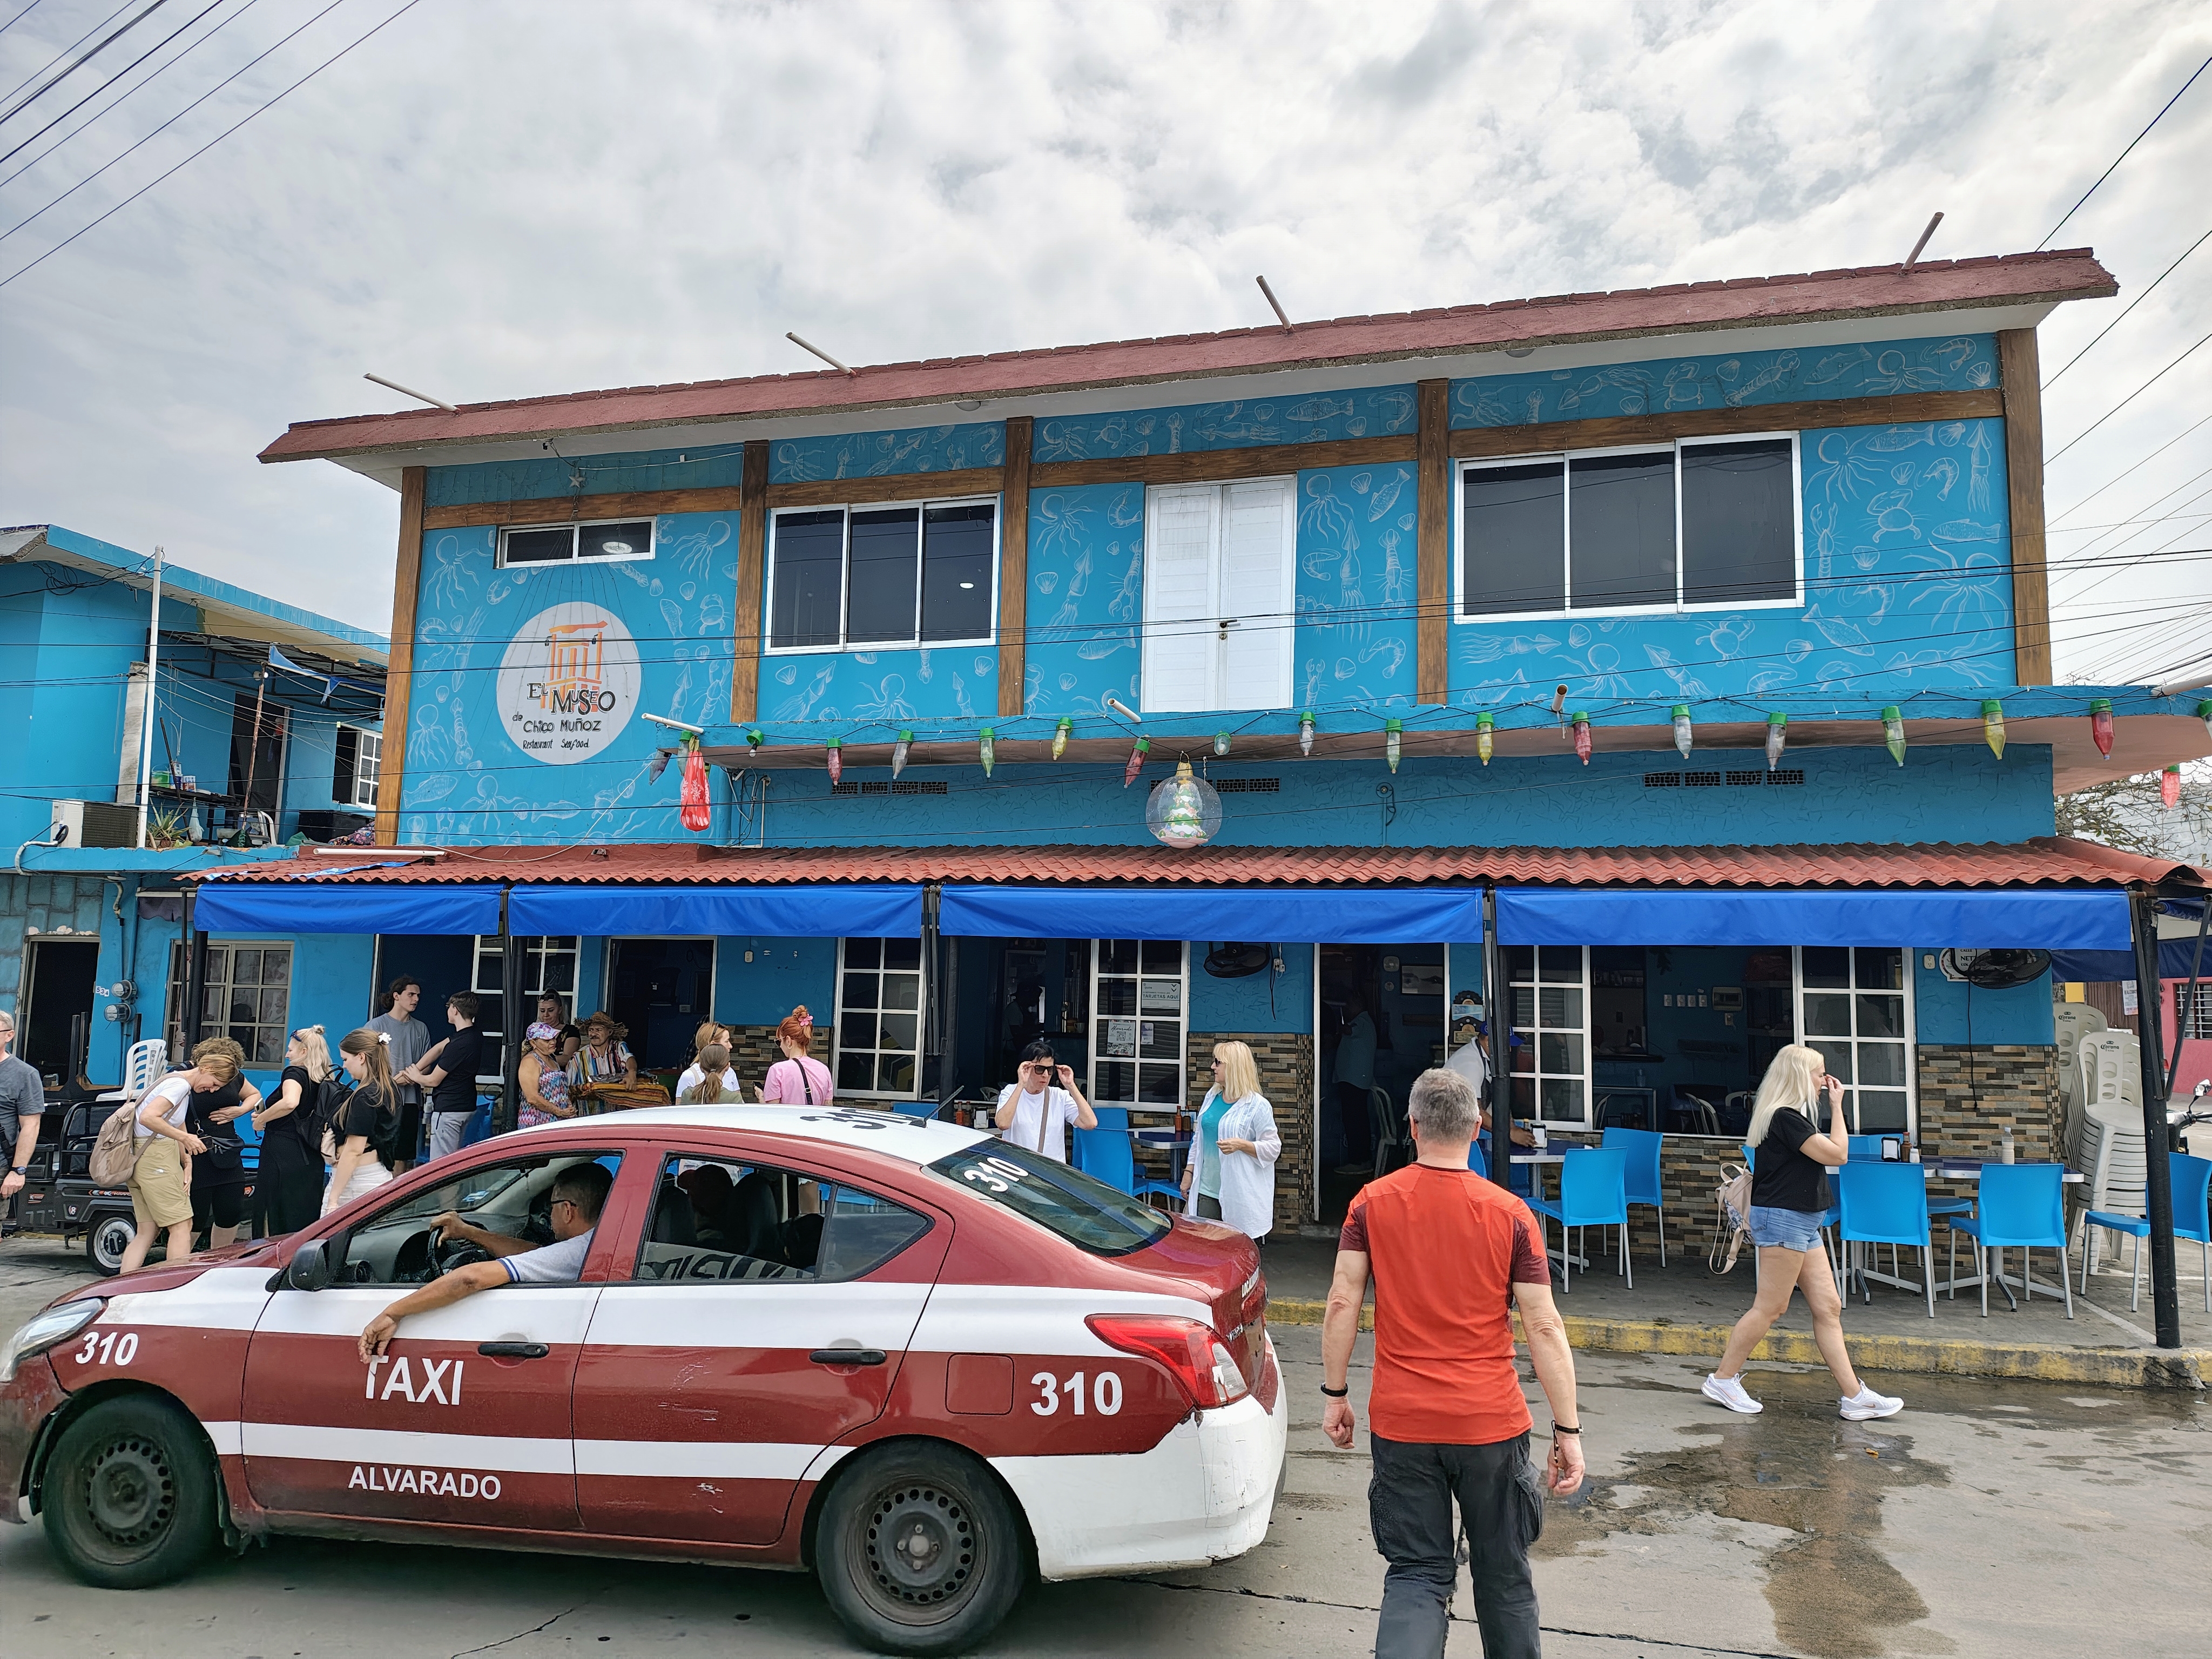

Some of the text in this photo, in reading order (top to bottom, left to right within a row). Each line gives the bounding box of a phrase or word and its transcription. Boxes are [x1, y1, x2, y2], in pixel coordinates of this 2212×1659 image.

[527, 683, 616, 715] EL MUSEO
[512, 711, 523, 721] de
[523, 720, 555, 733] Chico
[523, 738, 590, 751] Restaurant Seafood
[96, 987, 109, 996] 534
[964, 1156, 1030, 1192] 310
[75, 1331, 139, 1366] 310
[366, 1355, 464, 1405] TAXI
[1030, 1371, 1123, 1416] 310
[348, 1466, 501, 1500] ALVARADO
